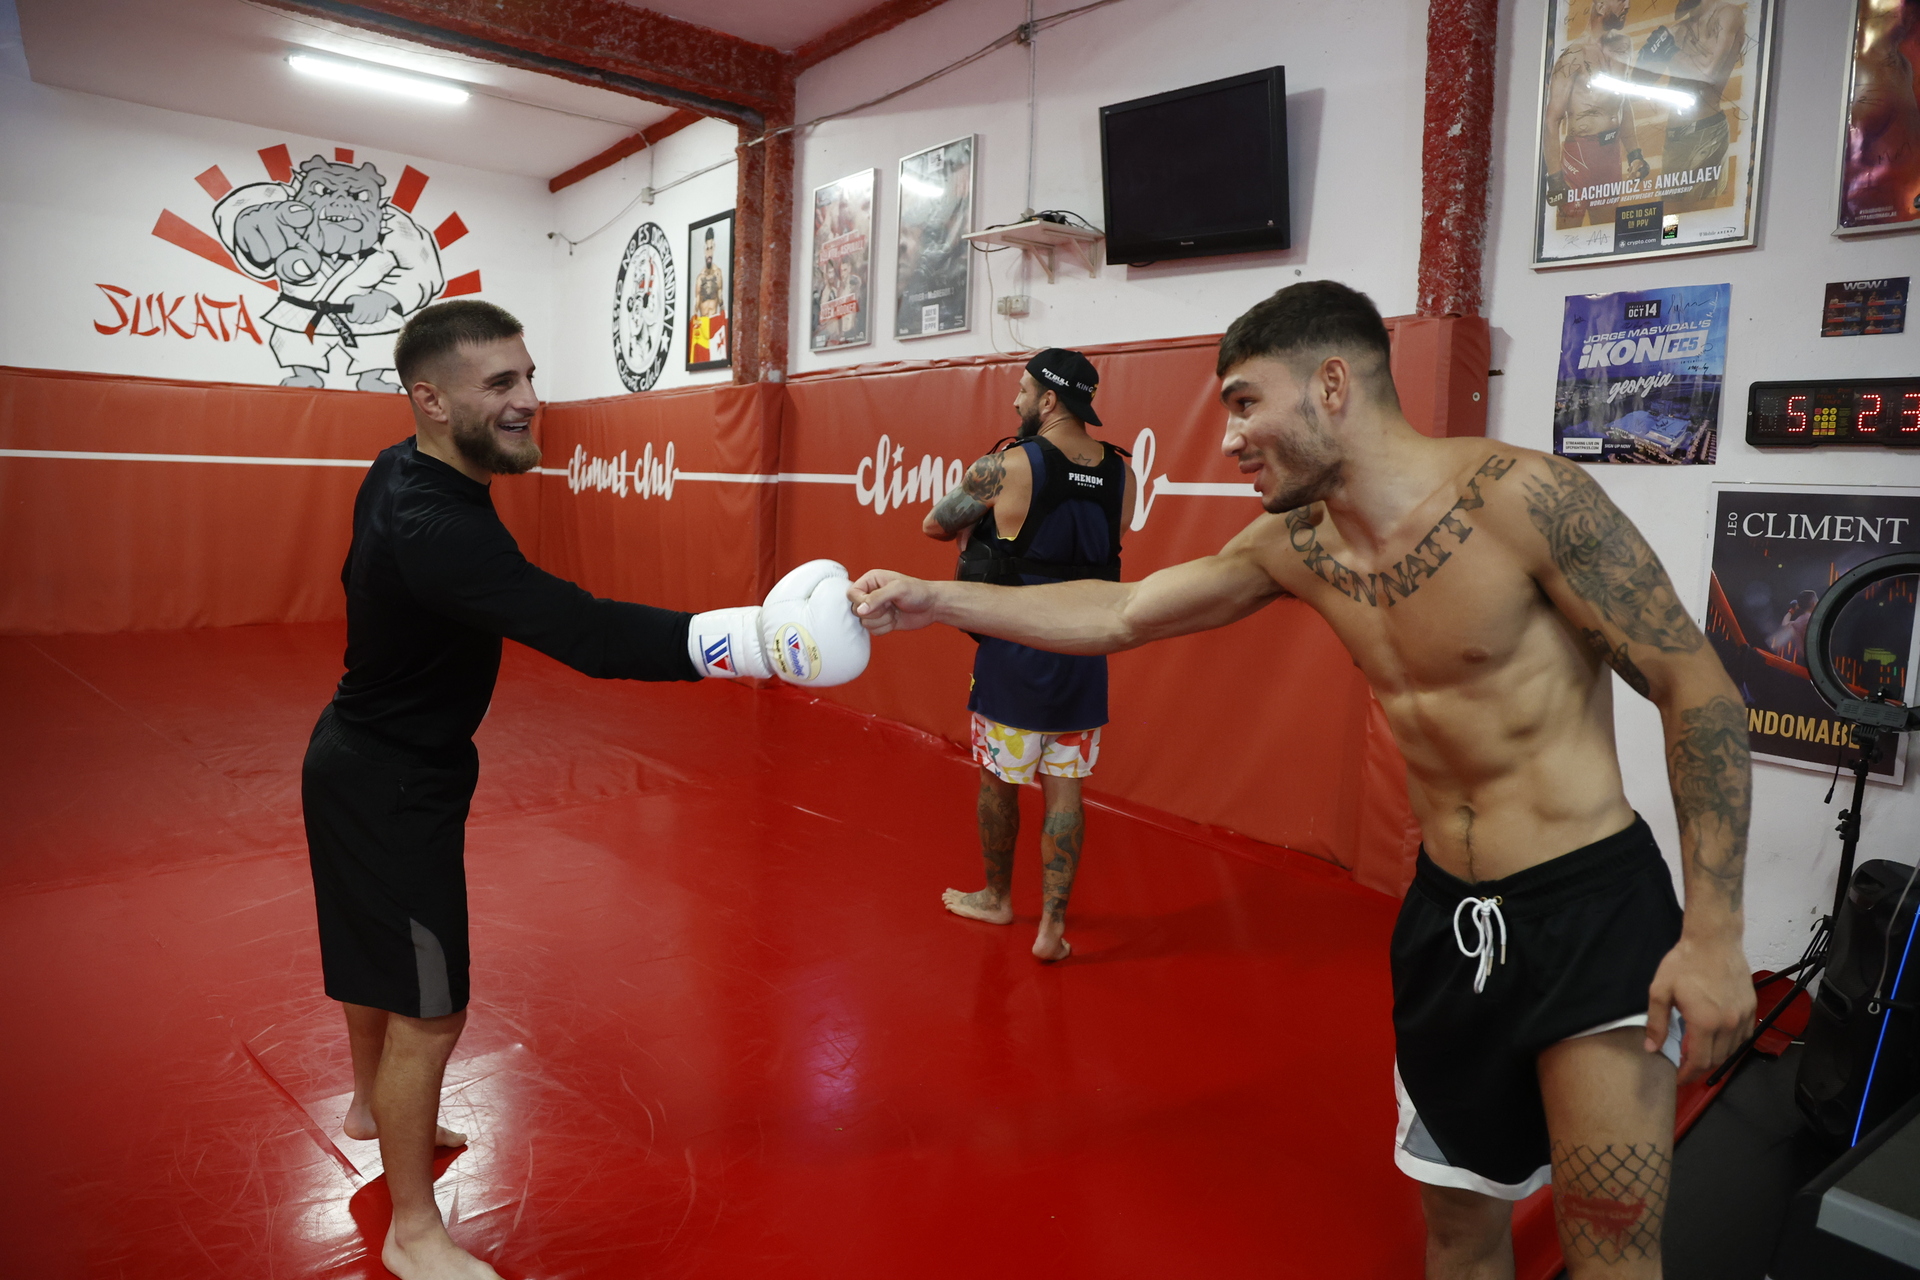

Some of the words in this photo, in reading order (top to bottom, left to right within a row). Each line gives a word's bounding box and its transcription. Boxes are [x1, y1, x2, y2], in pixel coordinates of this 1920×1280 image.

[1650, 31, 1668, 53] UFC
[1567, 179, 1640, 203] BLACHOWICZ
[1655, 166, 1722, 189] ANKALAEV
[1621, 192, 1654, 202] HEAVYWEIGHT
[1655, 186, 1693, 196] CHAMPIONSHIP
[1622, 211, 1634, 220] DEC
[1644, 207, 1657, 217] SAT
[1637, 219, 1649, 227] PPV
[638, 224, 650, 245] ES
[1627, 238, 1656, 246] crypto.com
[1843, 280, 1881, 290] WOW
[94, 283, 263, 345] SUKATA
[1628, 308, 1644, 318] OCT
[1645, 303, 1657, 316] 14
[1584, 332, 1626, 344] JORGE
[1628, 320, 1711, 338] MASVIDAL'S
[1578, 336, 1665, 369] iKON
[1608, 370, 1675, 404] georgia
[1788, 395, 1806, 431] 5
[1858, 394, 1881, 431] 2
[1901, 393, 1920, 431] 3
[567, 444, 628, 498] climent
[634, 441, 680, 501] club
[856, 434, 964, 516] clime
[1068, 472, 1103, 486] PHENOM
[1726, 512, 1738, 536] LEO
[1743, 512, 1909, 544] CLIMENT
[1746, 708, 1860, 750] NDOMABL
